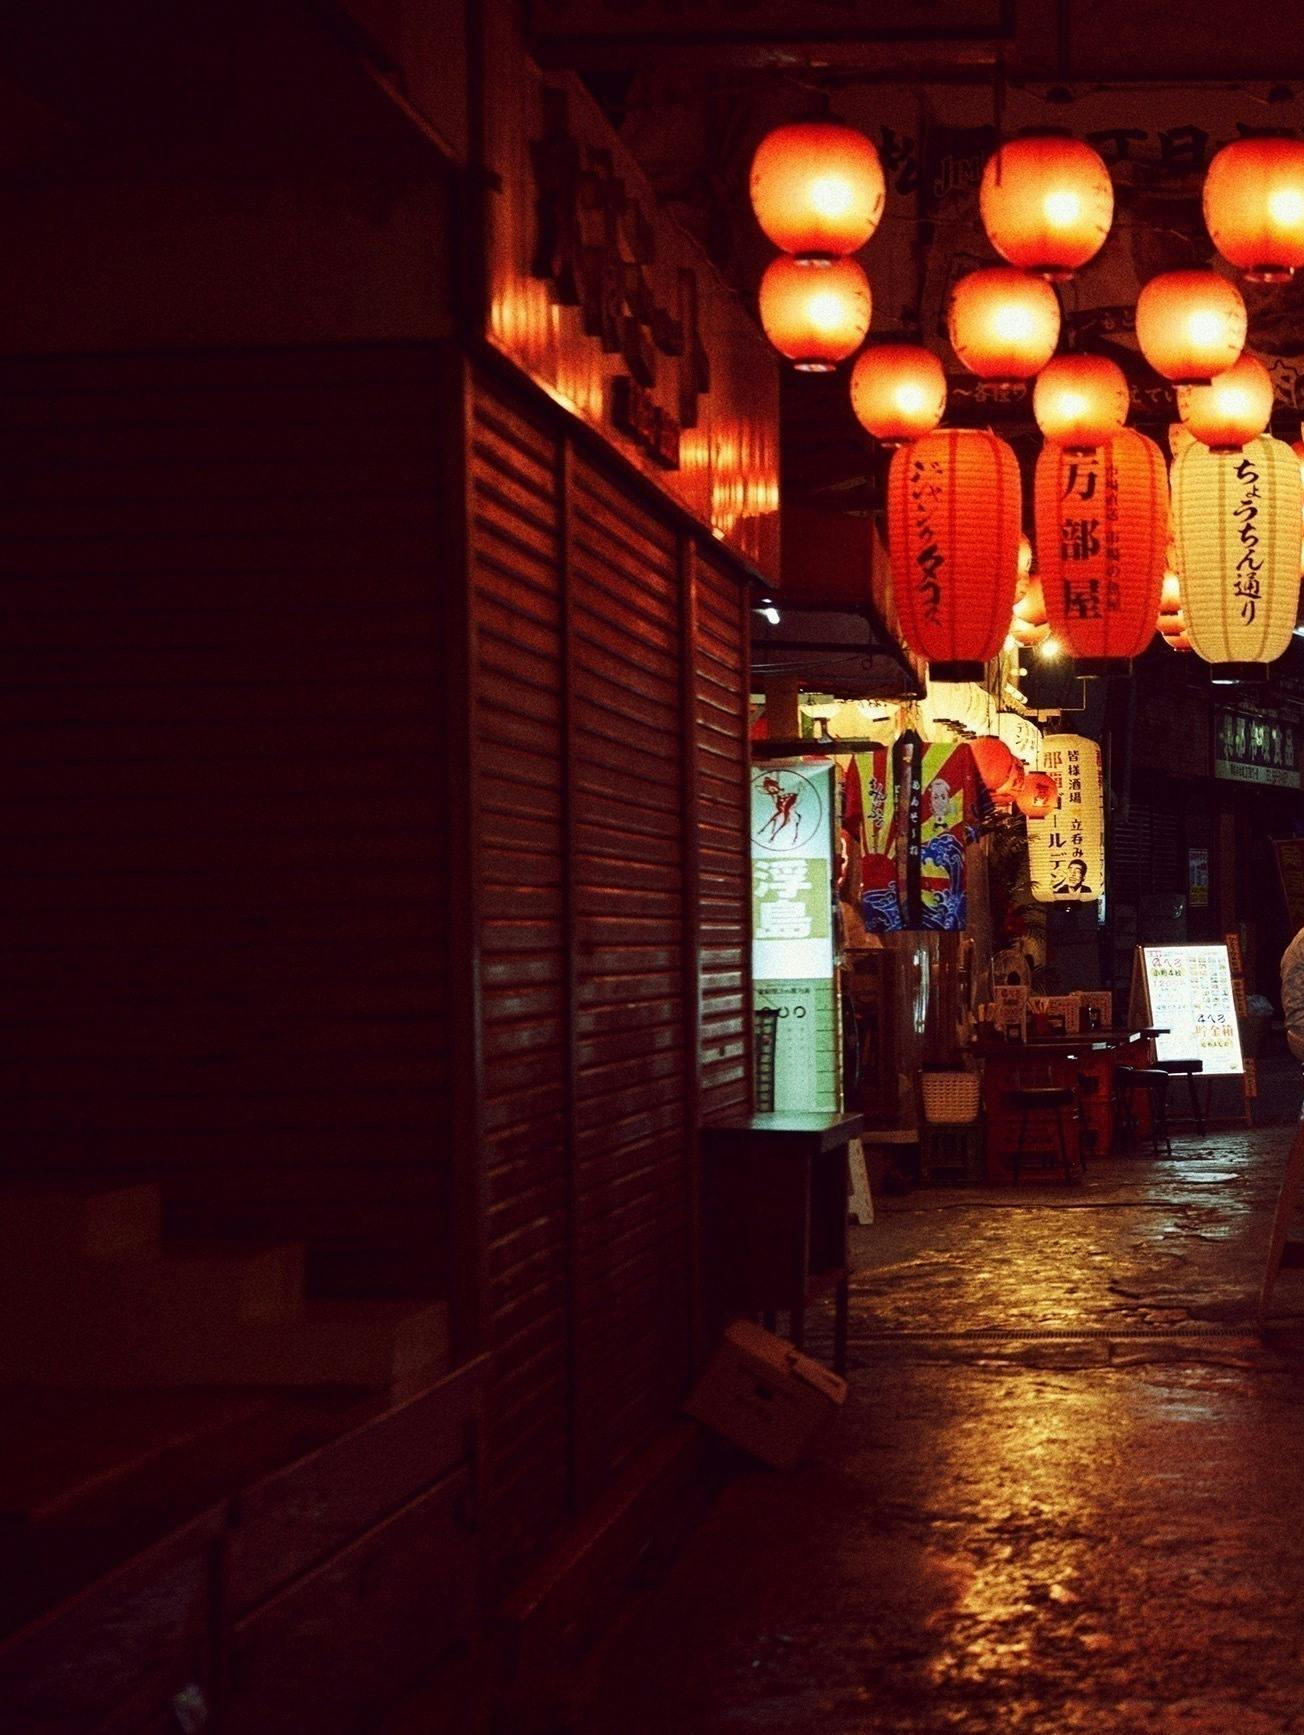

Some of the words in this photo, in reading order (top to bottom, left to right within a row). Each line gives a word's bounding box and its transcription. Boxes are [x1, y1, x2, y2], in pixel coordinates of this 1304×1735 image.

[1060, 457, 1101, 619] 万部屋
[1233, 458, 1264, 626] ちょうちん通り
[1067, 751, 1081, 804] 皆様酒場
[1070, 820, 1082, 857] 立呑み
